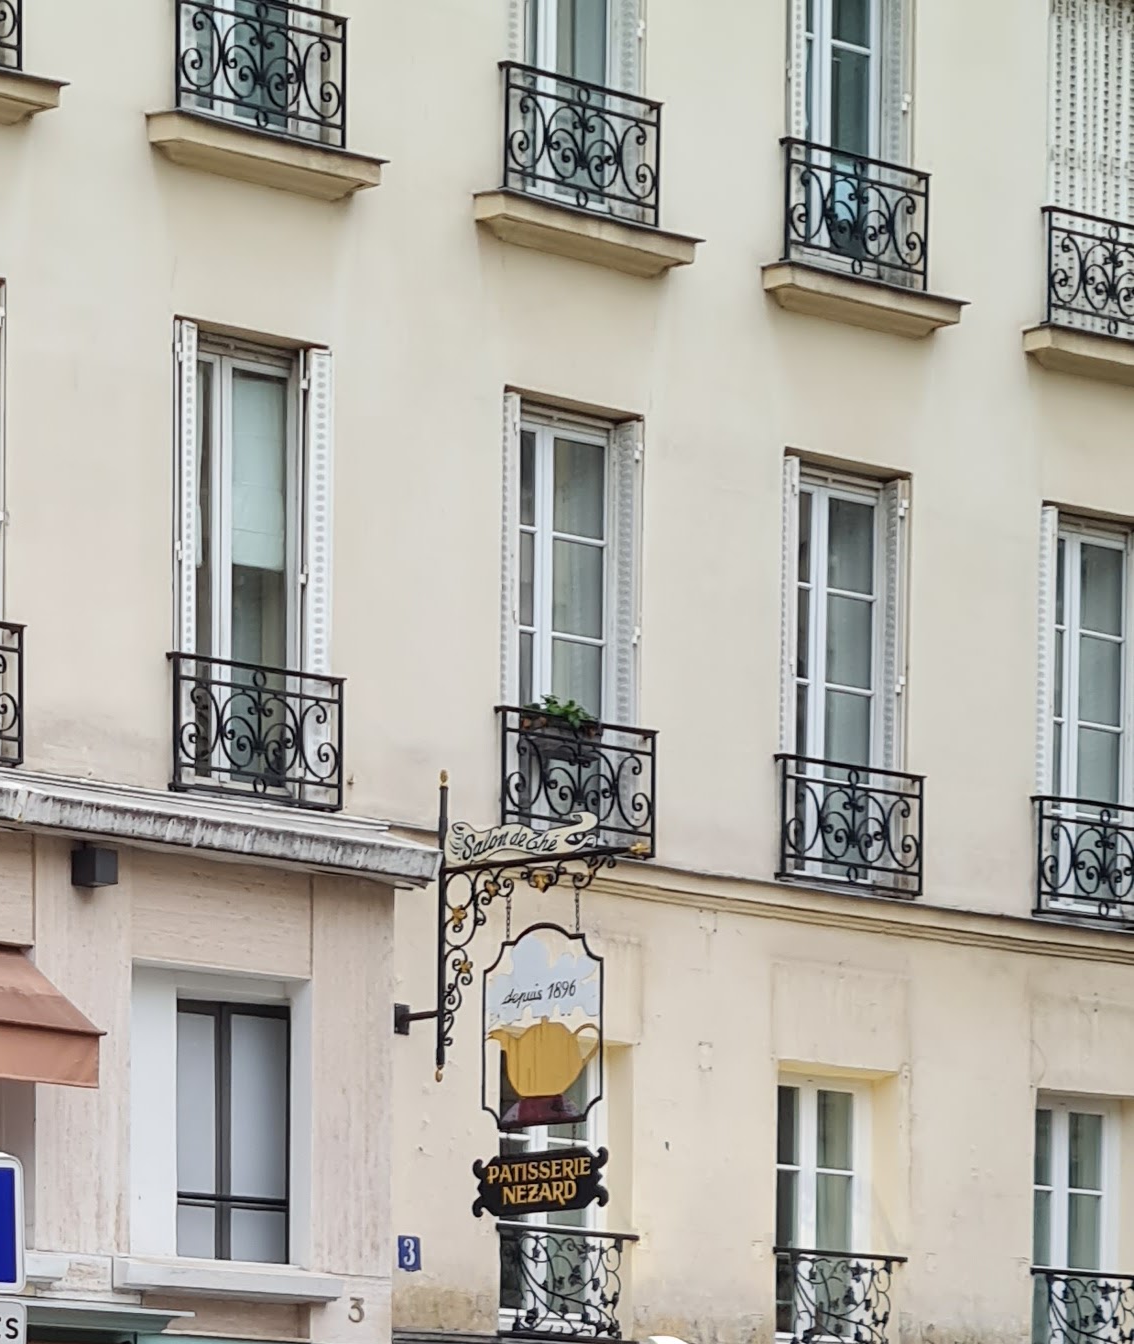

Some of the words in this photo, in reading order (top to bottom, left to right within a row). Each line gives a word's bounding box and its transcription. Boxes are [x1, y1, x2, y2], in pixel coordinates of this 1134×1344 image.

[462, 830, 508, 861] Salon
[510, 826, 528, 848] de
[501, 984, 543, 1009] depuis
[547, 980, 578, 1000] 1896
[487, 1156, 592, 1185] PATISSERIE
[502, 1180, 578, 1206] NEZARD
[403, 1238, 416, 1266] 3
[348, 1296, 365, 1323] 3
